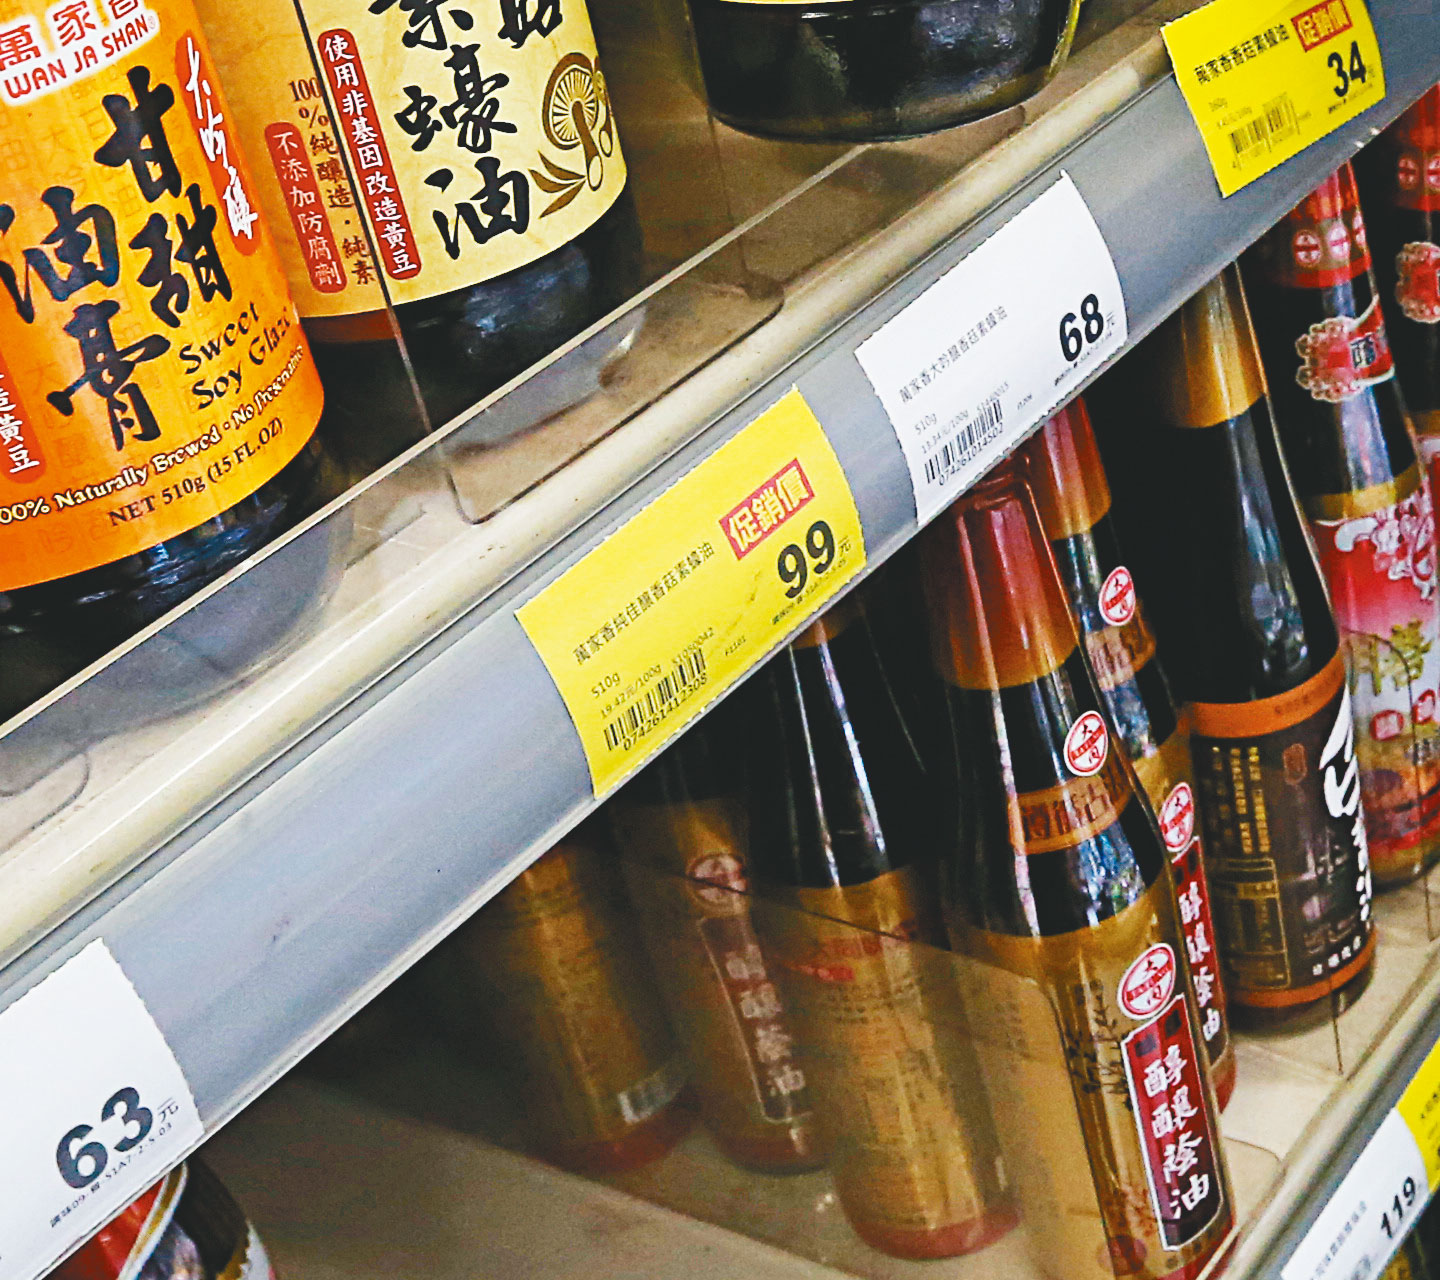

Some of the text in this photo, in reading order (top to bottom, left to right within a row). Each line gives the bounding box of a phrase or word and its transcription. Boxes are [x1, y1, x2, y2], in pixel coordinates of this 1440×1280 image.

[5, 15, 150, 99] WAN JA SHAN
[1327, 39, 1368, 98] 34
[323, 36, 418, 273] 使用非基因改造黃豆
[94, 65, 233, 328] 甘甜
[276, 131, 343, 287] 不添加防腐劑
[177, 299, 260, 376] Sweet
[1059, 293, 1105, 362] 68
[192, 368, 243, 412] Soy
[914, 412, 938, 436] 510g
[54, 462, 151, 510] Naturally
[152, 426, 222, 477] Brewed
[231, 403, 257, 430] No
[109, 495, 159, 529] NET
[163, 473, 208, 506] 510g
[728, 465, 810, 552] 促銷價
[777, 520, 836, 600] 99
[591, 672, 622, 699] 510g
[55, 1086, 180, 1189] 63 元
[1379, 1175, 1417, 1239] 119
